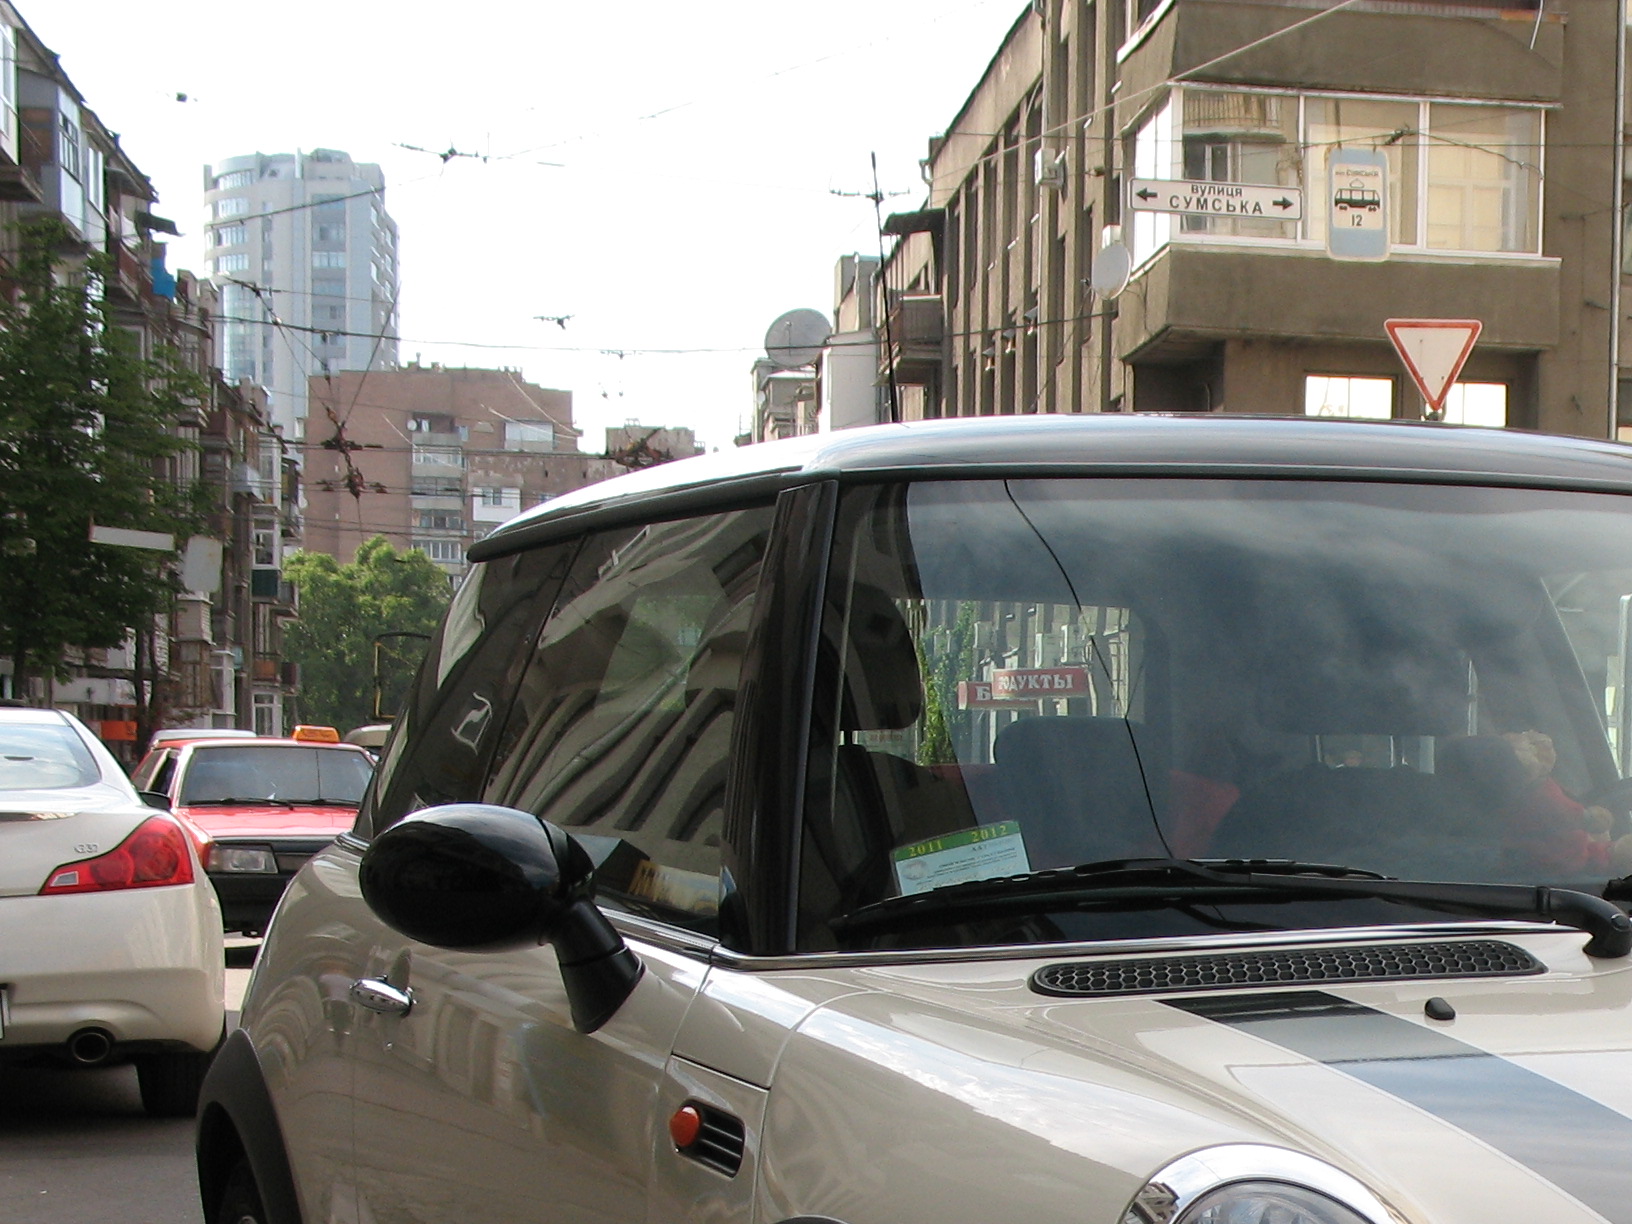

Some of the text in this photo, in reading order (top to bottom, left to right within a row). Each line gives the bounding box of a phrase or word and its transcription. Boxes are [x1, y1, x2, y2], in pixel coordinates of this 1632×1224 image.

[1191, 184, 1243, 198] вулиця
[1169, 195, 1263, 215] СУМСЬКА
[1351, 213, 1363, 227] 12
[909, 825, 1008, 857] 2011 2012
